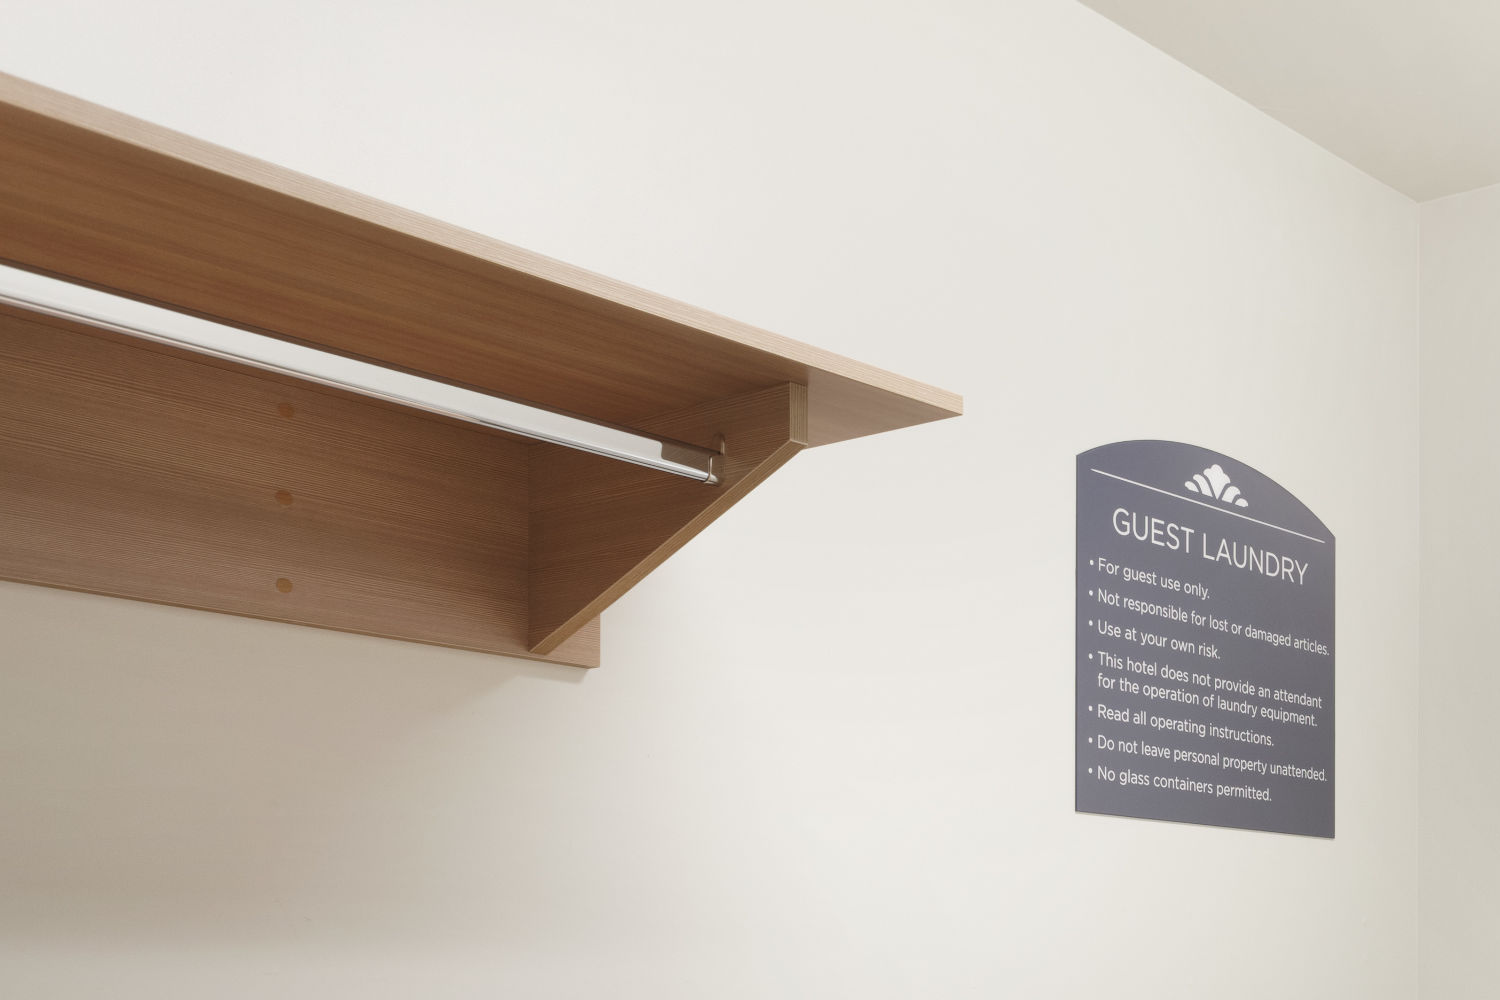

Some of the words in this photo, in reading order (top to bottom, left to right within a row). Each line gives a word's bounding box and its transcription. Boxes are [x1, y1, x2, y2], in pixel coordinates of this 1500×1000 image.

[1113, 508, 1194, 553] GUEST
[1203, 533, 1308, 584] LAUNDRY
[1099, 557, 1119, 575] For
[1123, 568, 1157, 585] guest
[1161, 577, 1180, 591] use
[1184, 583, 1209, 600] only.
[1098, 588, 1120, 606] Not
[1124, 598, 1188, 622] responsible
[1191, 611, 1206, 626] for
[1210, 615, 1228, 632] lost
[1231, 624, 1242, 635] or
[1245, 624, 1291, 646] damaged
[1294, 639, 1329, 655] articles.
[1098, 619, 1121, 637] Use
[1125, 628, 1137, 641] at
[1141, 632, 1167, 647] your
[1171, 639, 1195, 653] own
[1199, 643, 1220, 659] risk.
[1098, 651, 1123, 669] This
[1127, 657, 1156, 676] hotel
[1161, 665, 1188, 682] does
[1193, 674, 1211, 687] not
[1215, 678, 1255, 695] provide
[1258, 687, 1270, 698] an
[1274, 689, 1322, 710] attendant
[1098, 673, 1115, 689] for
[1120, 678, 1139, 694] the
[1143, 685, 1199, 704] operation
[1203, 694, 1214, 707] of
[1218, 696, 1257, 717] laundry
[1261, 707, 1317, 726] equipment.
[1098, 704, 1129, 722] Read
[1133, 711, 1146, 725] all
[1150, 716, 1206, 737] operating
[1210, 723, 1274, 746] instructions.
[1098, 735, 1114, 750] Do
[1119, 741, 1138, 754] not
[1142, 741, 1170, 758] leave
[1174, 750, 1219, 766] personal
[1223, 757, 1267, 775] property
[1270, 764, 1327, 781] unattended.
[1098, 766, 1115, 781] No
[1119, 769, 1149, 785] glass
[1154, 777, 1213, 793] containers
[1217, 785, 1271, 801] permitted.
